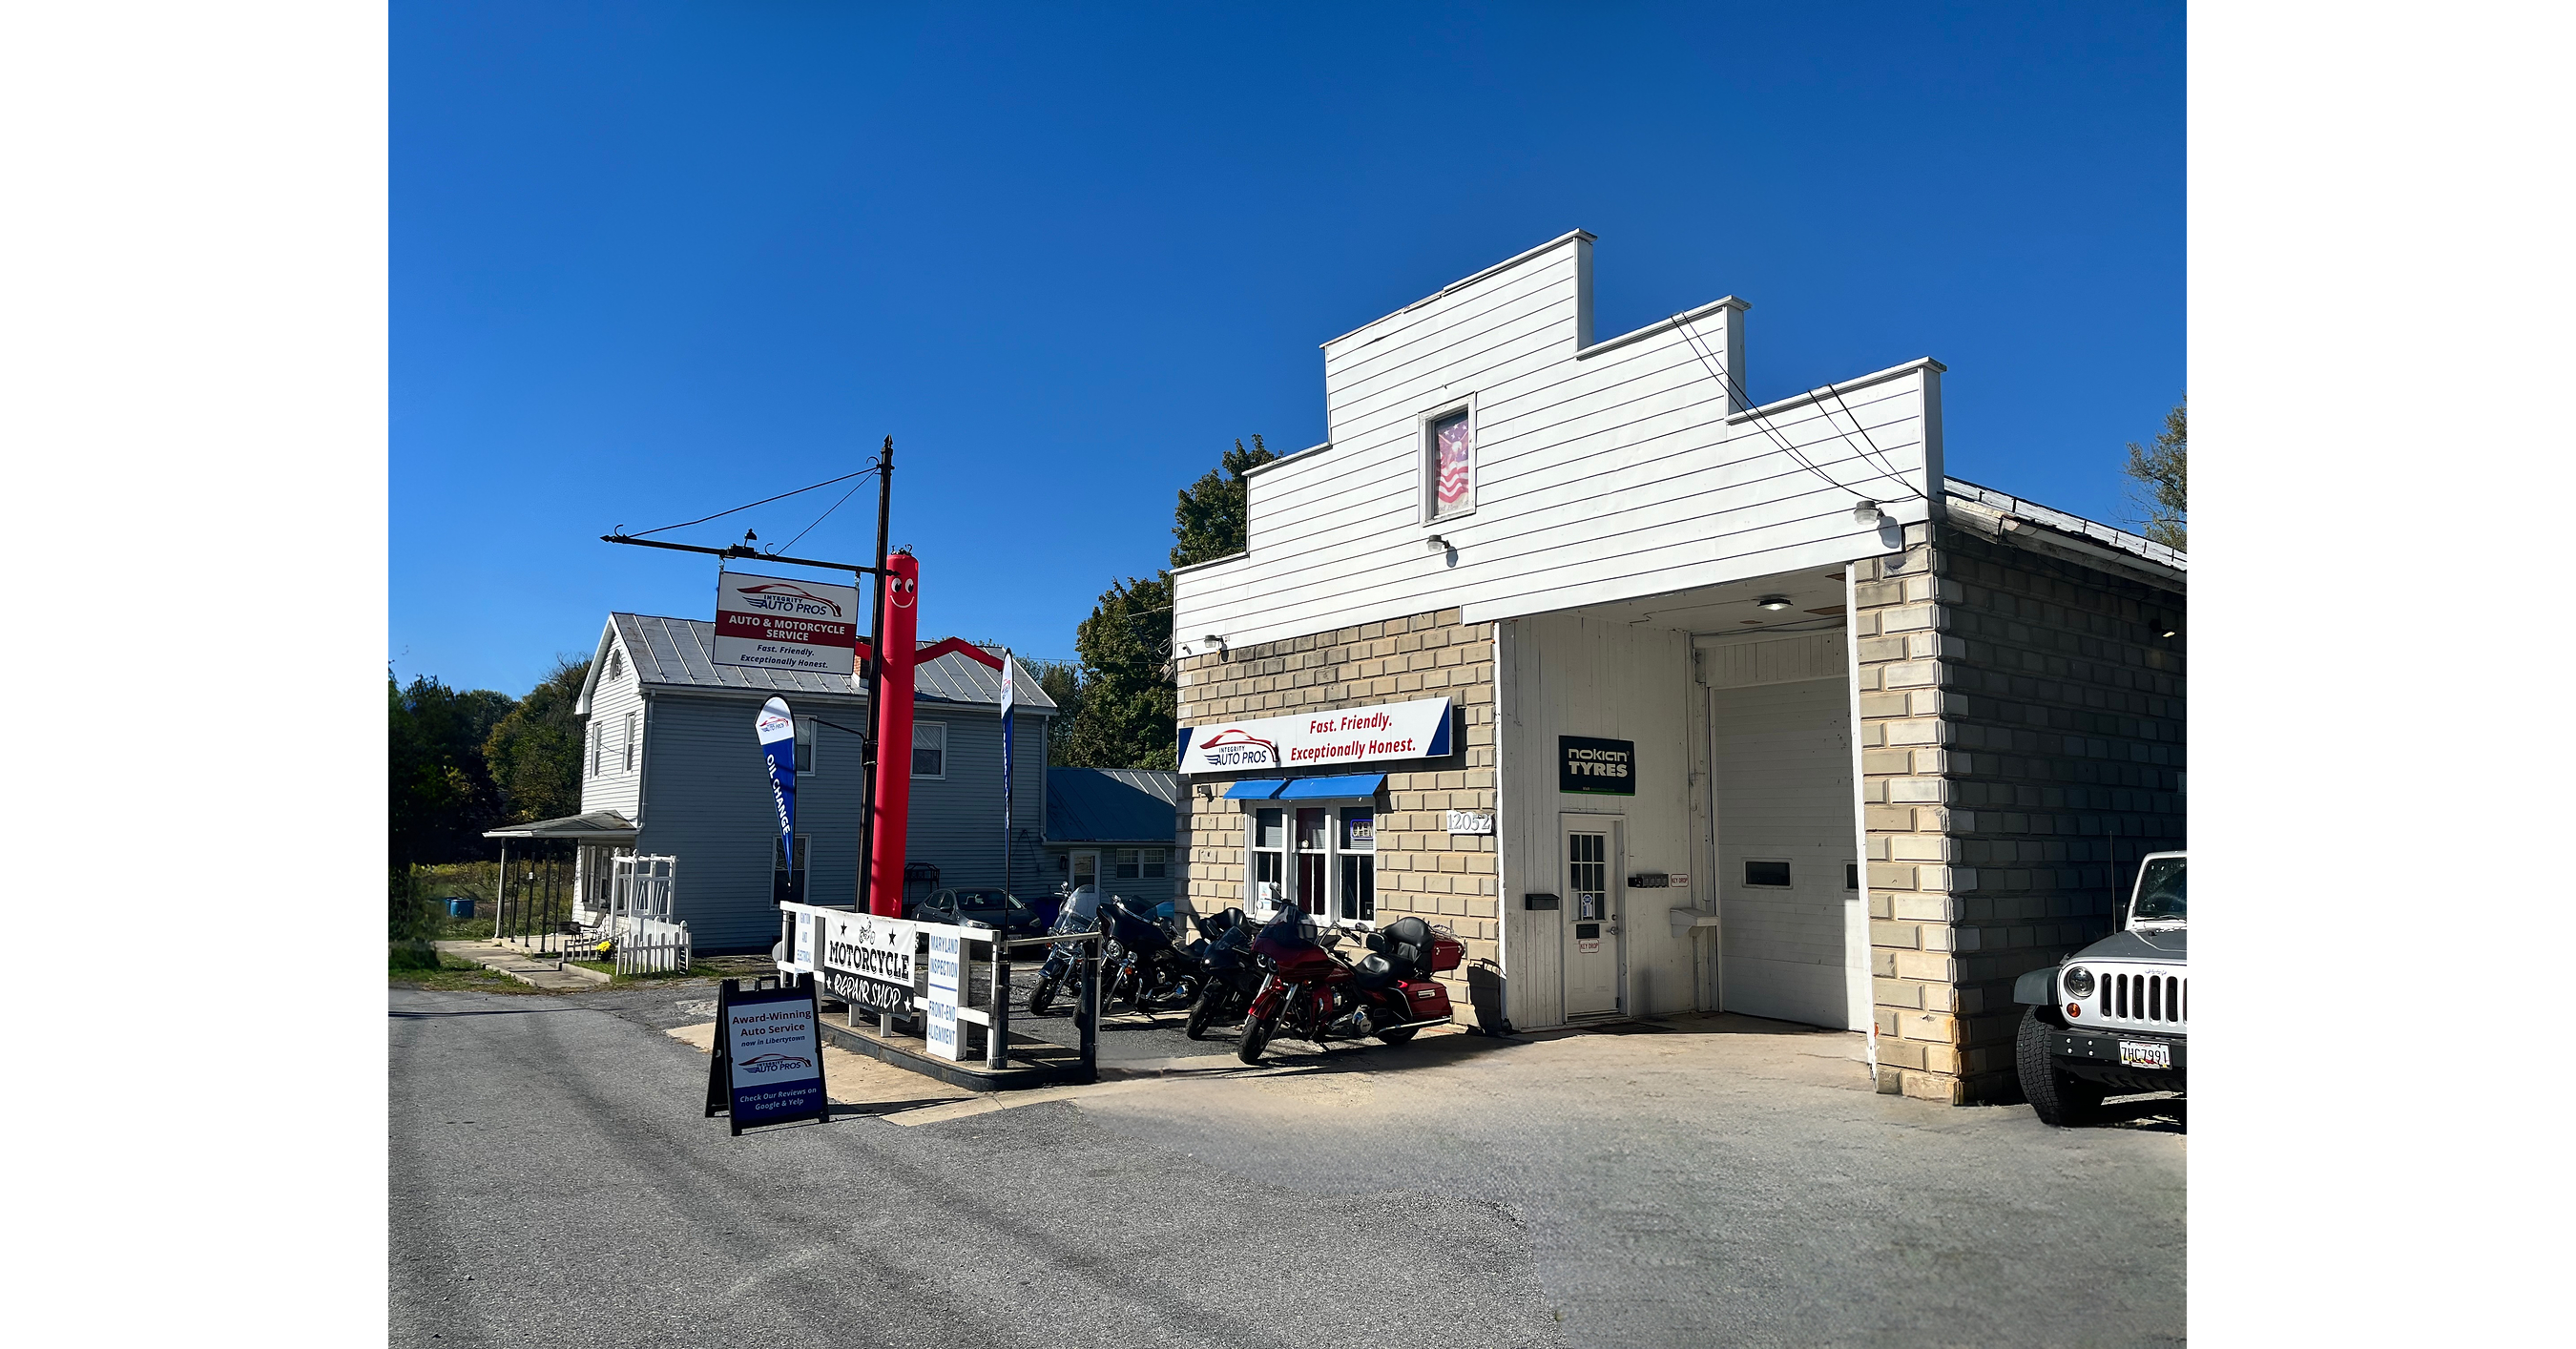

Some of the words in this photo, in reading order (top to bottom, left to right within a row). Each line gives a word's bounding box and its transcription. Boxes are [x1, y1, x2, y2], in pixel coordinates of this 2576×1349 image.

[764, 595, 802, 603] INTEGRITY
[760, 600, 793, 612] AUTO
[796, 603, 827, 615] PROS
[729, 615, 760, 626] AUTO
[763, 619, 771, 627] &
[774, 620, 845, 634] MOTORCYCLE
[766, 630, 809, 641] SERVICE
[757, 644, 777, 653] Fast.
[780, 646, 814, 657] Friendly.
[740, 654, 796, 667] Exceptionally
[798, 660, 828, 668] Honest.
[1309, 719, 1337, 734] Fast.
[1340, 712, 1392, 731] Friendly.
[1291, 740, 1365, 762] Exceptionally
[1368, 737, 1416, 755] Honest.
[1215, 752, 1240, 766] AUTO
[1242, 750, 1267, 764] PROS
[1568, 761, 1628, 777] TYRES
[766, 754, 776, 779] OIL
[772, 778, 790, 836] CHANGE
[1353, 821, 1373, 837] OPEN
[1447, 813, 1492, 830] 12052
[931, 935, 958, 954] MARYLAND
[829, 940, 910, 982] MOTORCYCLE
[930, 957, 958, 978] INSPECTION
[834, 974, 870, 1004] REPAIR
[871, 983, 901, 1012] SHOP
[732, 1010, 811, 1024] Award-Winning
[929, 1000, 956, 1022] FRONT-END
[740, 1027, 766, 1037] Auto
[769, 1024, 805, 1034] Service
[928, 1023, 956, 1046] ALIGNMENT
[766, 1035, 805, 1045] Libertytown
[756, 1064, 778, 1073] AUTO
[780, 1062, 801, 1070] PROS
[740, 1093, 762, 1102] Check
[778, 1088, 806, 1098] Reviews
[755, 1101, 780, 1110] Google
[789, 1098, 804, 1106] Yelp
